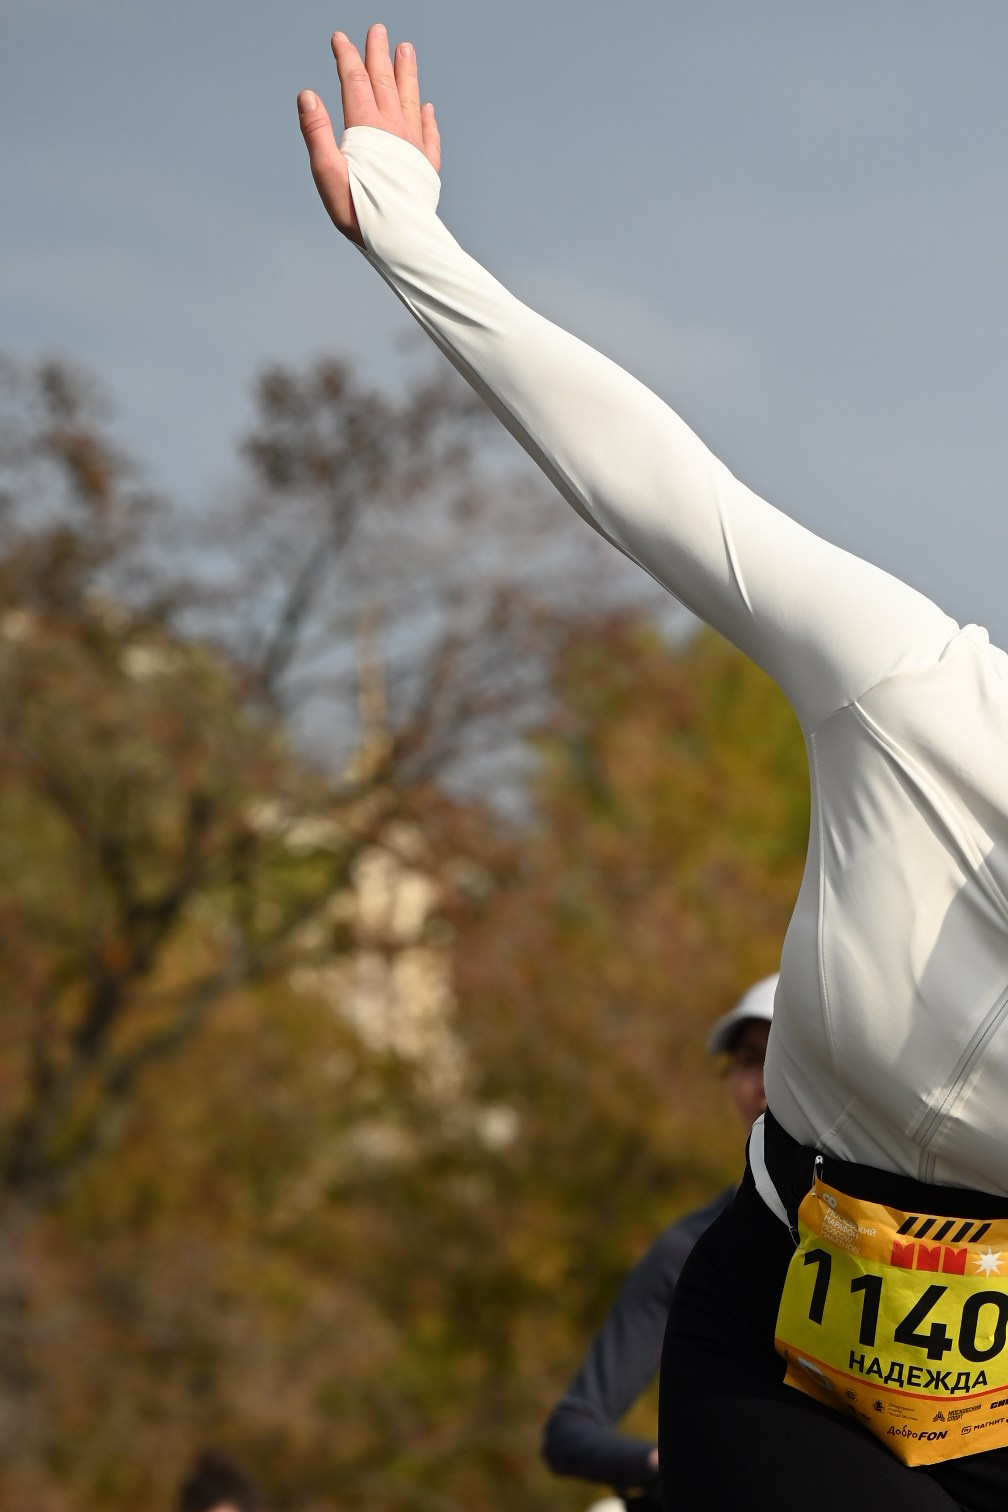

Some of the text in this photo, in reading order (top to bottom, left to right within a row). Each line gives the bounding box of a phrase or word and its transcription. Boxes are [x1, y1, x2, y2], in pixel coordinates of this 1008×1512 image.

[824, 1215, 858, 1239] МАРАФОН
[849, 1350, 988, 1394] НАДЕЖДА
[974, 1417, 1005, 1431] МАГНИТ
